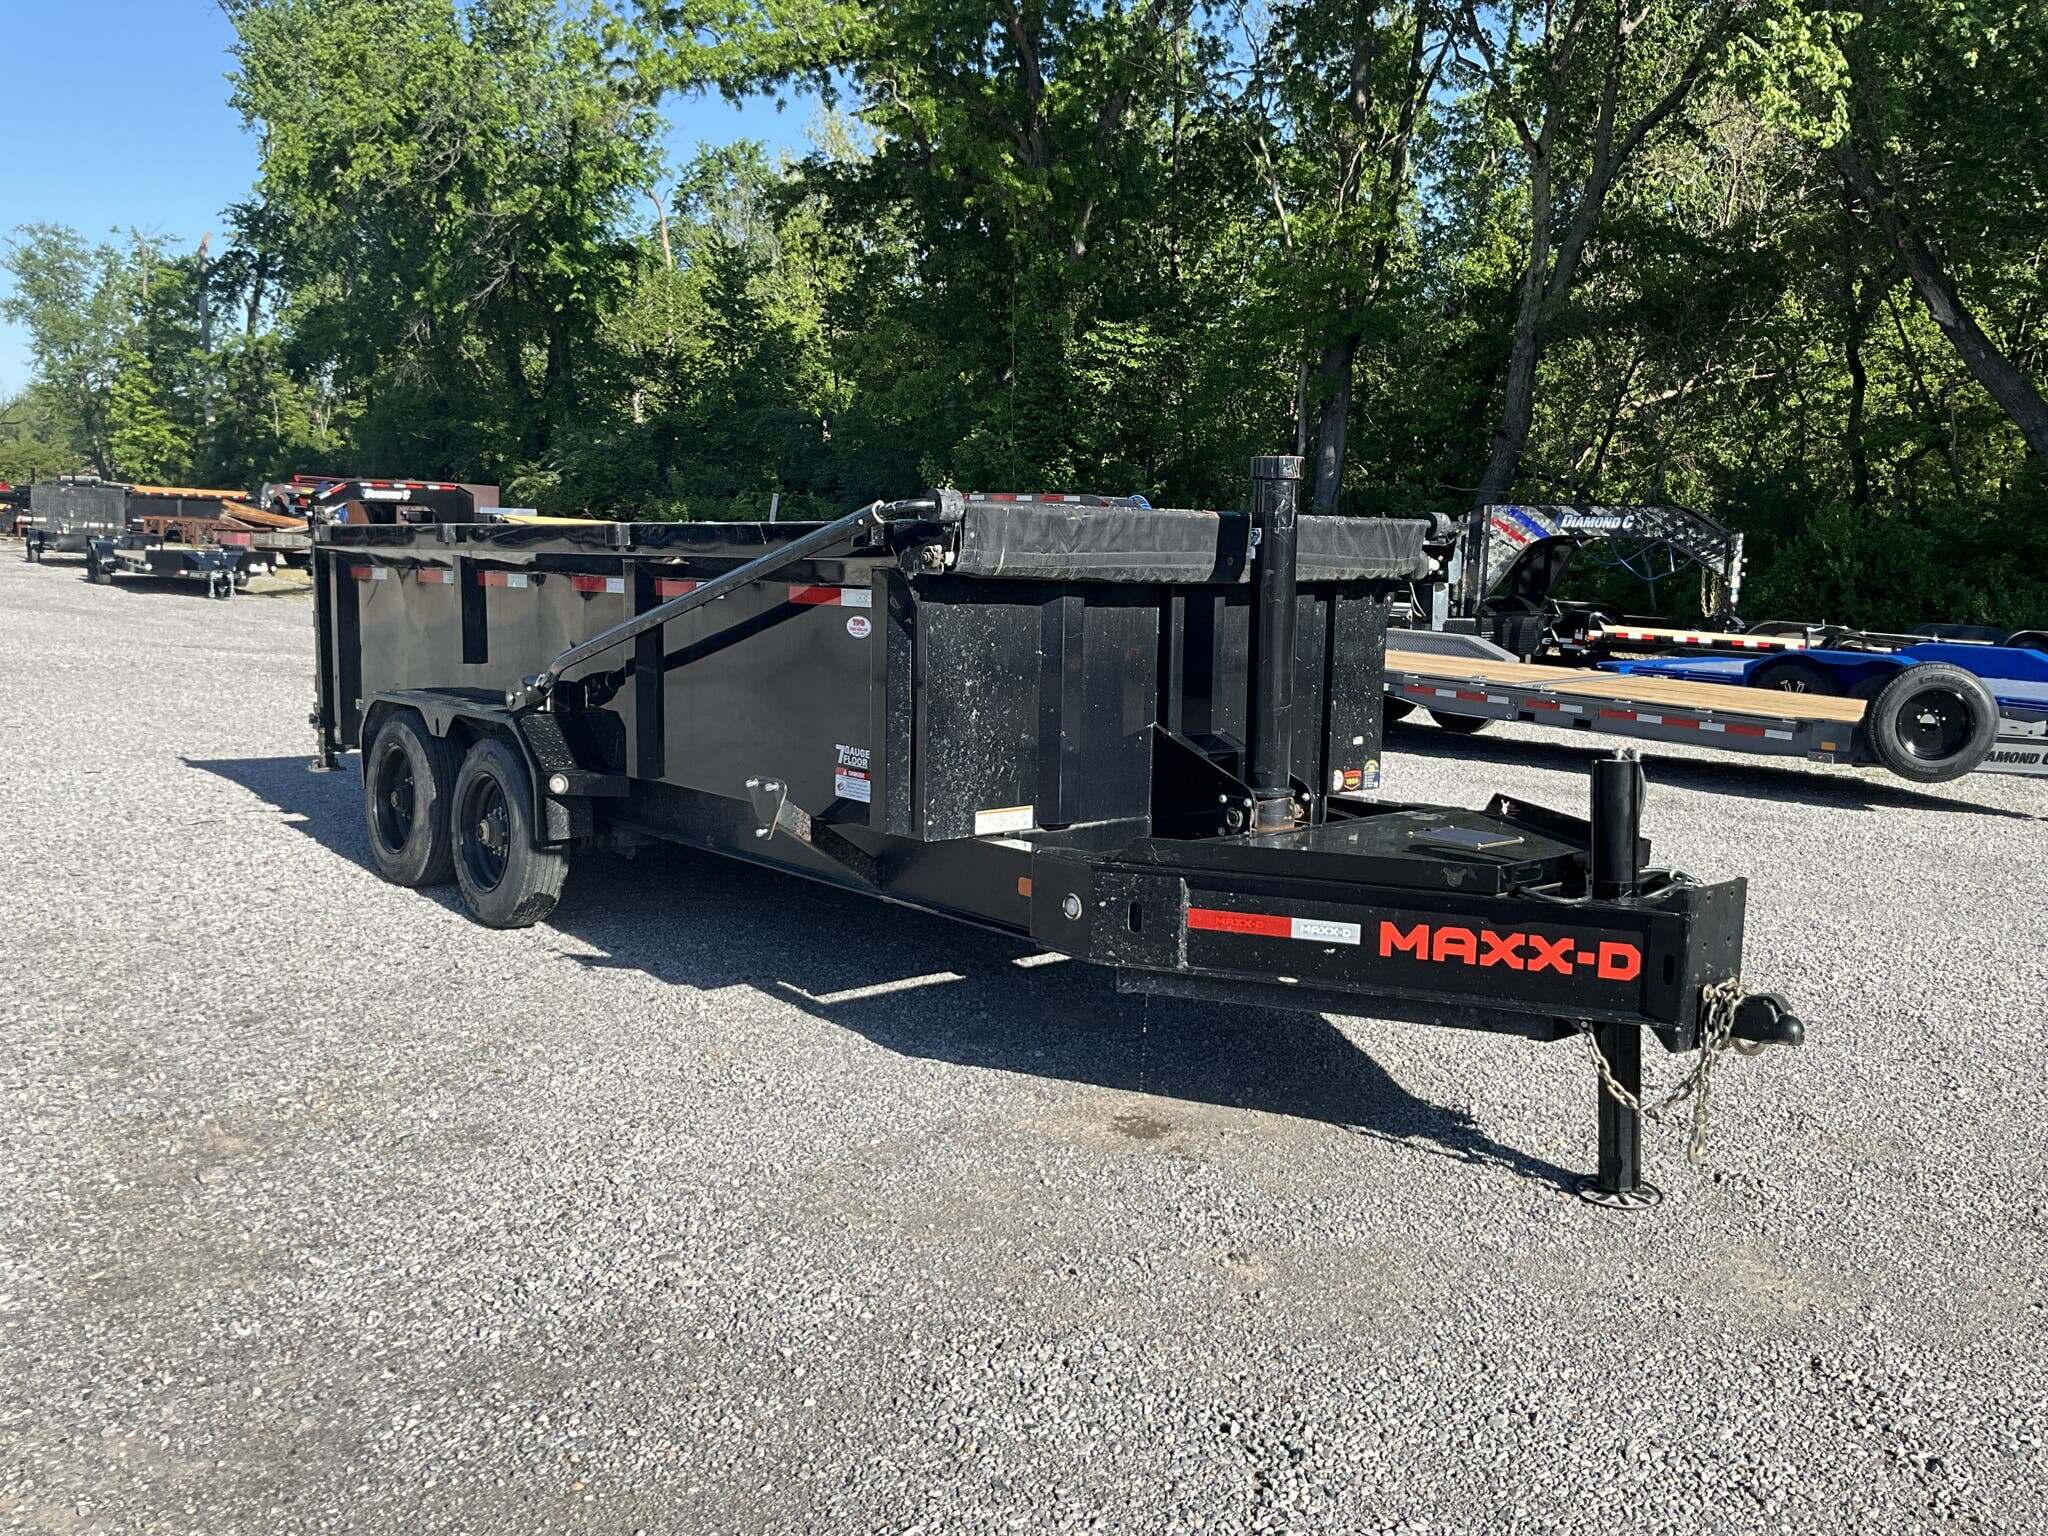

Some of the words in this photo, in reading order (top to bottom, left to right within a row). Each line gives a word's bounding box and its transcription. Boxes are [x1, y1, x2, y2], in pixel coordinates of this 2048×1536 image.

[1560, 514, 1621, 528] DIAMOND
[1622, 514, 1635, 529] C
[835, 743, 845, 764] 7
[844, 745, 871, 759] GAUGE
[1984, 750, 2041, 765] AMOND
[843, 754, 868, 769] FLOOR
[1378, 921, 1642, 981] MAXX-D
